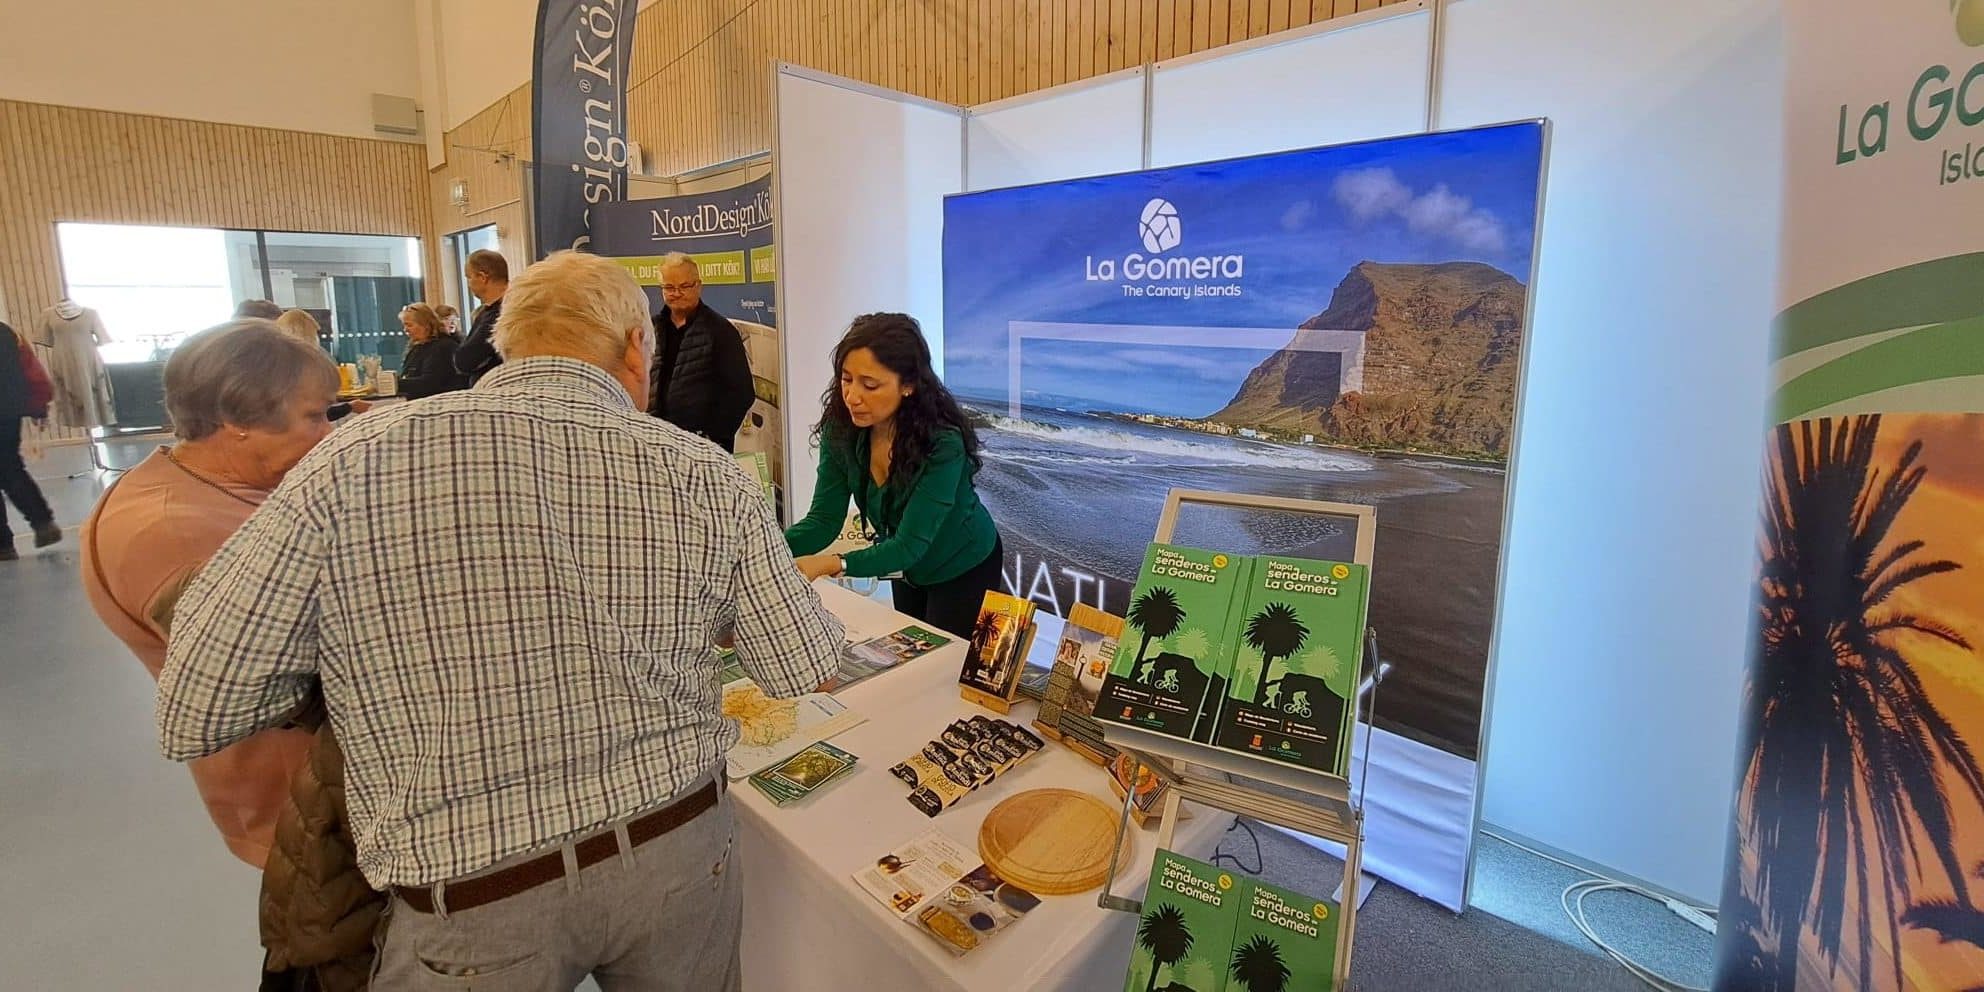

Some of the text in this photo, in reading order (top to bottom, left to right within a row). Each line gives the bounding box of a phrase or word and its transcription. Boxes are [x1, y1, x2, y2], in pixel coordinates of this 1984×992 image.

[573, 0, 617, 86] Kö
[1836, 101, 1890, 166] La
[705, 263, 722, 277] DITT
[1086, 253, 1243, 281] La Gomera
[1122, 284, 1242, 300] The Canary Islands
[1157, 548, 1178, 559] Mapa
[1155, 556, 1210, 572] senderos
[1268, 561, 1293, 571] Mapa
[1151, 564, 1216, 583] La Gomera
[1267, 569, 1329, 584] senderos
[1264, 578, 1337, 596] La Gomera
[1165, 857, 1186, 873] Mapa
[1163, 867, 1216, 892] senderos
[1160, 876, 1221, 907] La Gomera
[1254, 886, 1277, 901] Mapa
[1253, 895, 1311, 922] senderos
[1250, 906, 1317, 938] La Gomera
